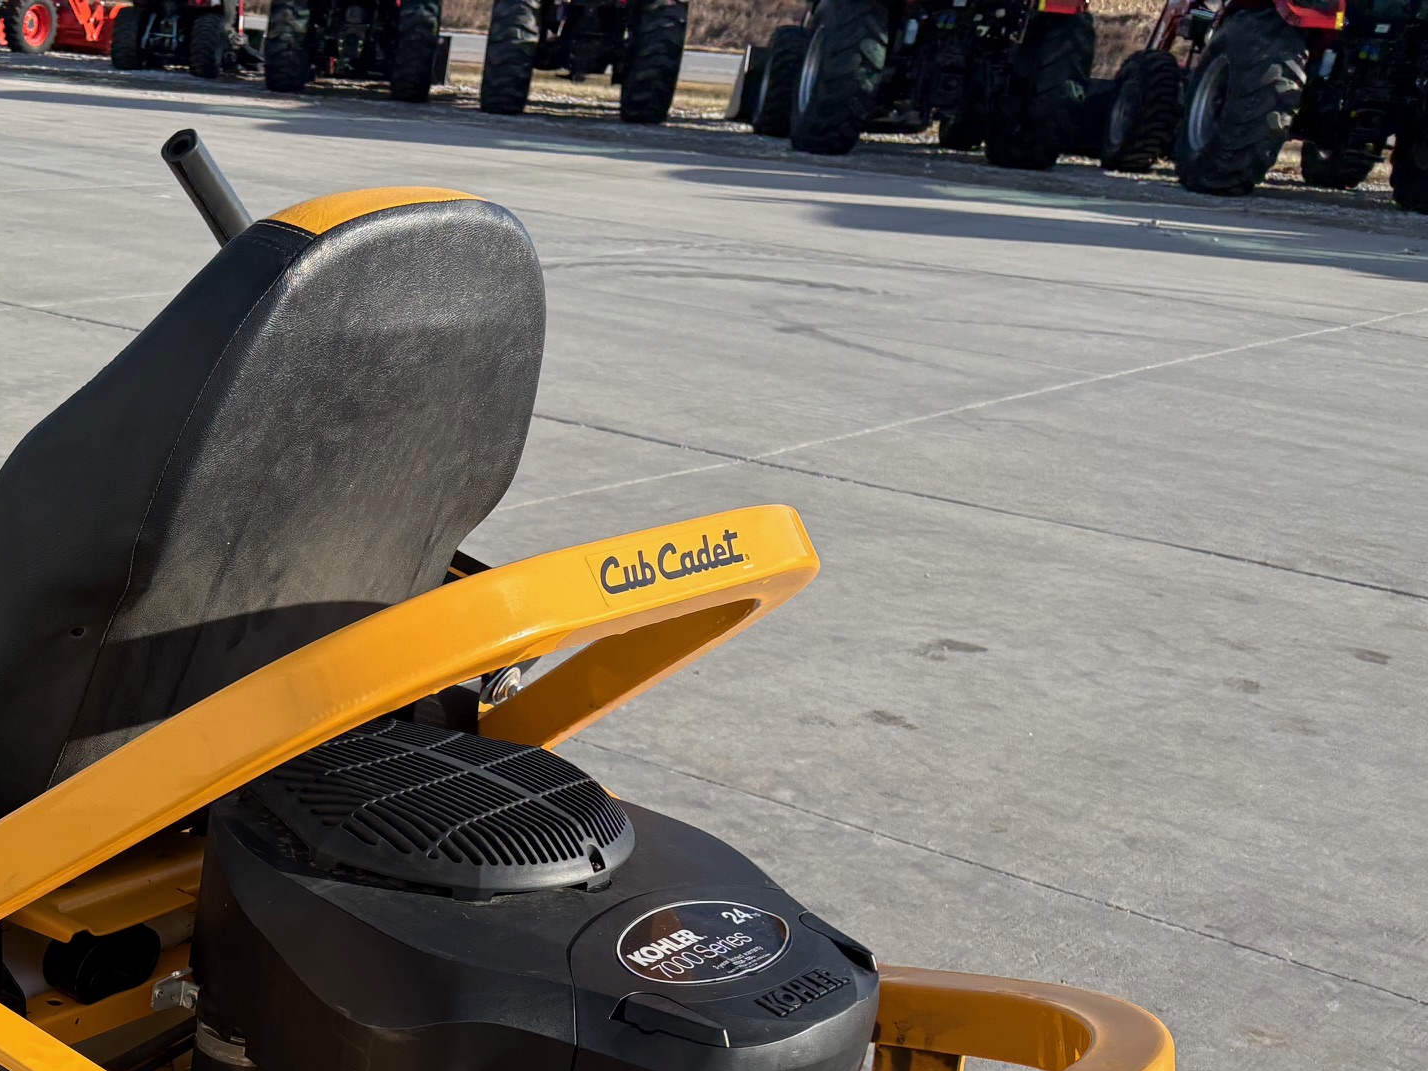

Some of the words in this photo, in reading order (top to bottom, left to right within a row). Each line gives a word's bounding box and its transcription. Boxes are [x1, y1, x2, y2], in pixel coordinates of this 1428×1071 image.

[600, 549, 656, 594] Cub
[657, 529, 744, 580] Cadet
[721, 908, 754, 925] 24
[626, 928, 704, 967] KOHLER
[650, 949, 705, 979] 7000
[693, 932, 753, 959] Series
[753, 968, 852, 1018] KOHLER
